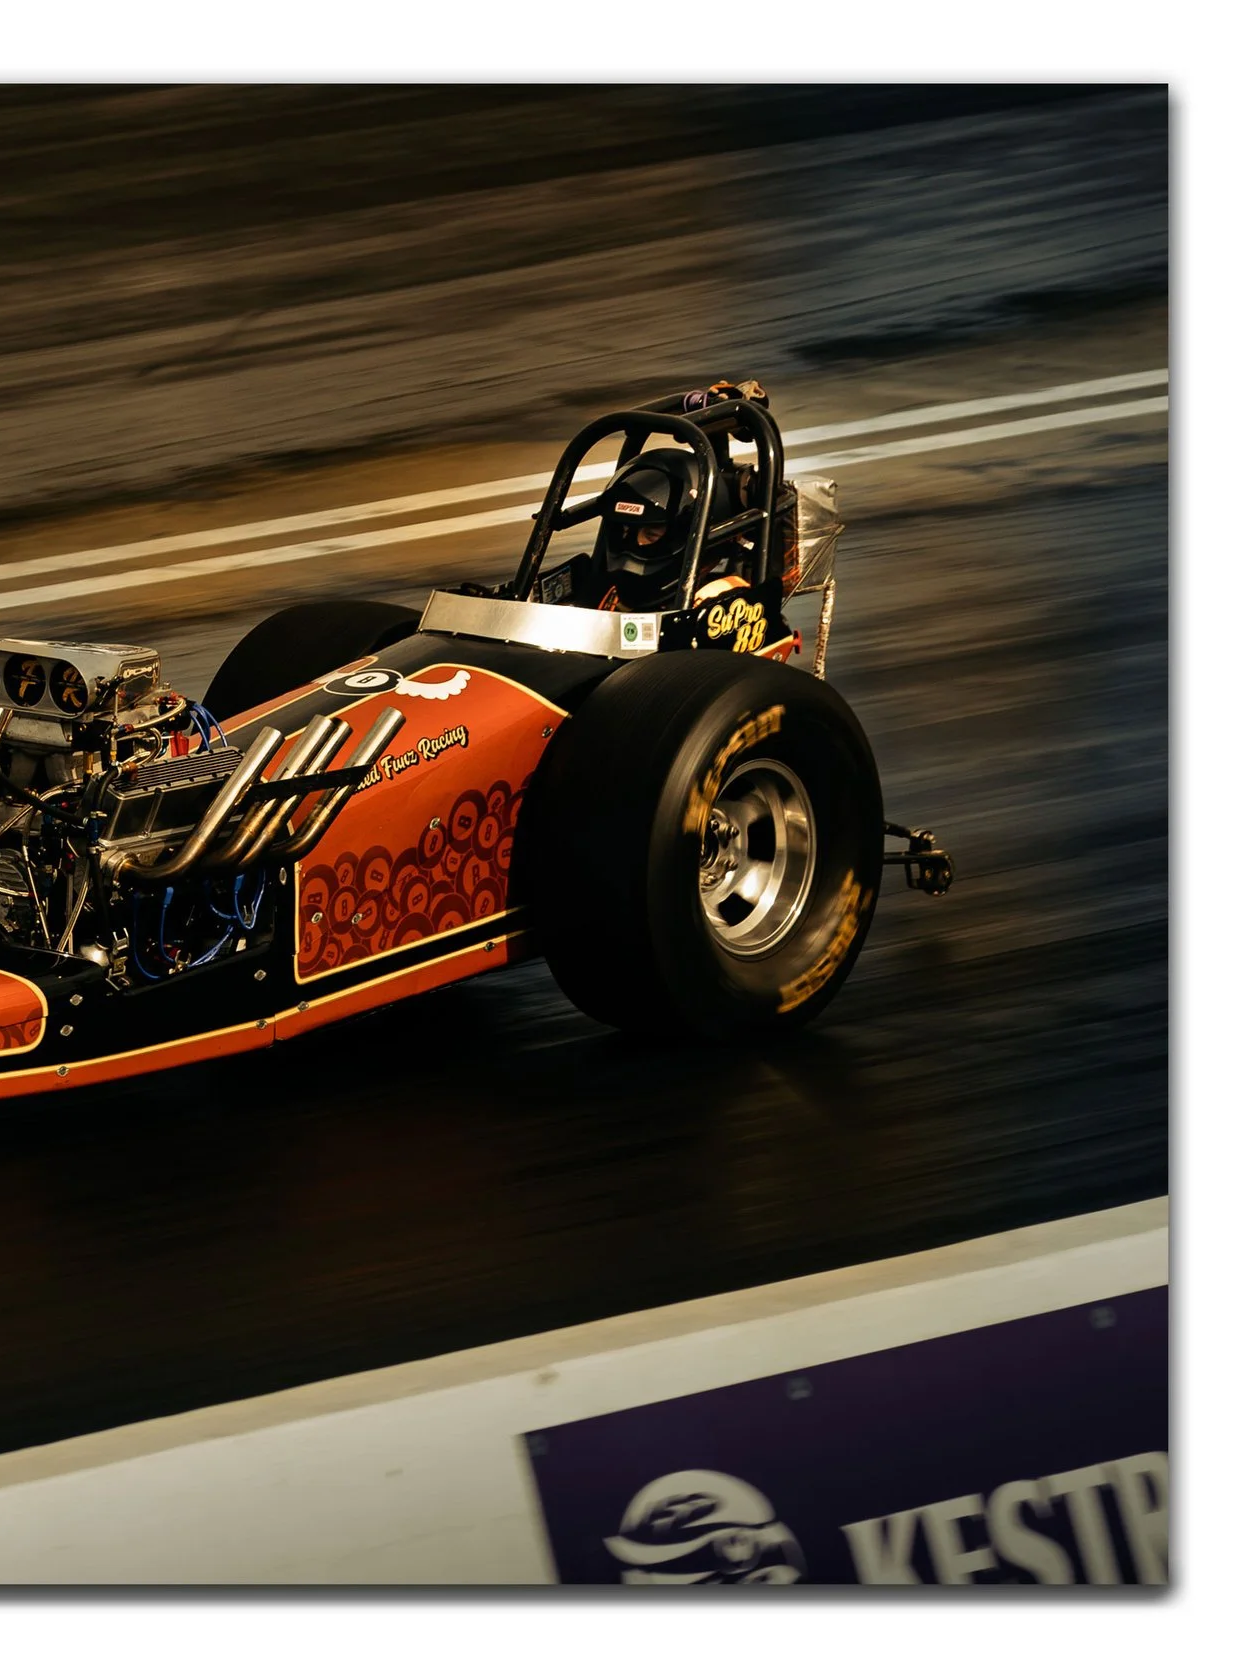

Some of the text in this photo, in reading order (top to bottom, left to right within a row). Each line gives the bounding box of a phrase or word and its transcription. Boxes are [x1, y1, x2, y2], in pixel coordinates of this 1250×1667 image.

[707, 597, 765, 640] SuPro
[732, 618, 768, 654] 88
[380, 749, 418, 778] Funz
[417, 725, 467, 759] Racing
